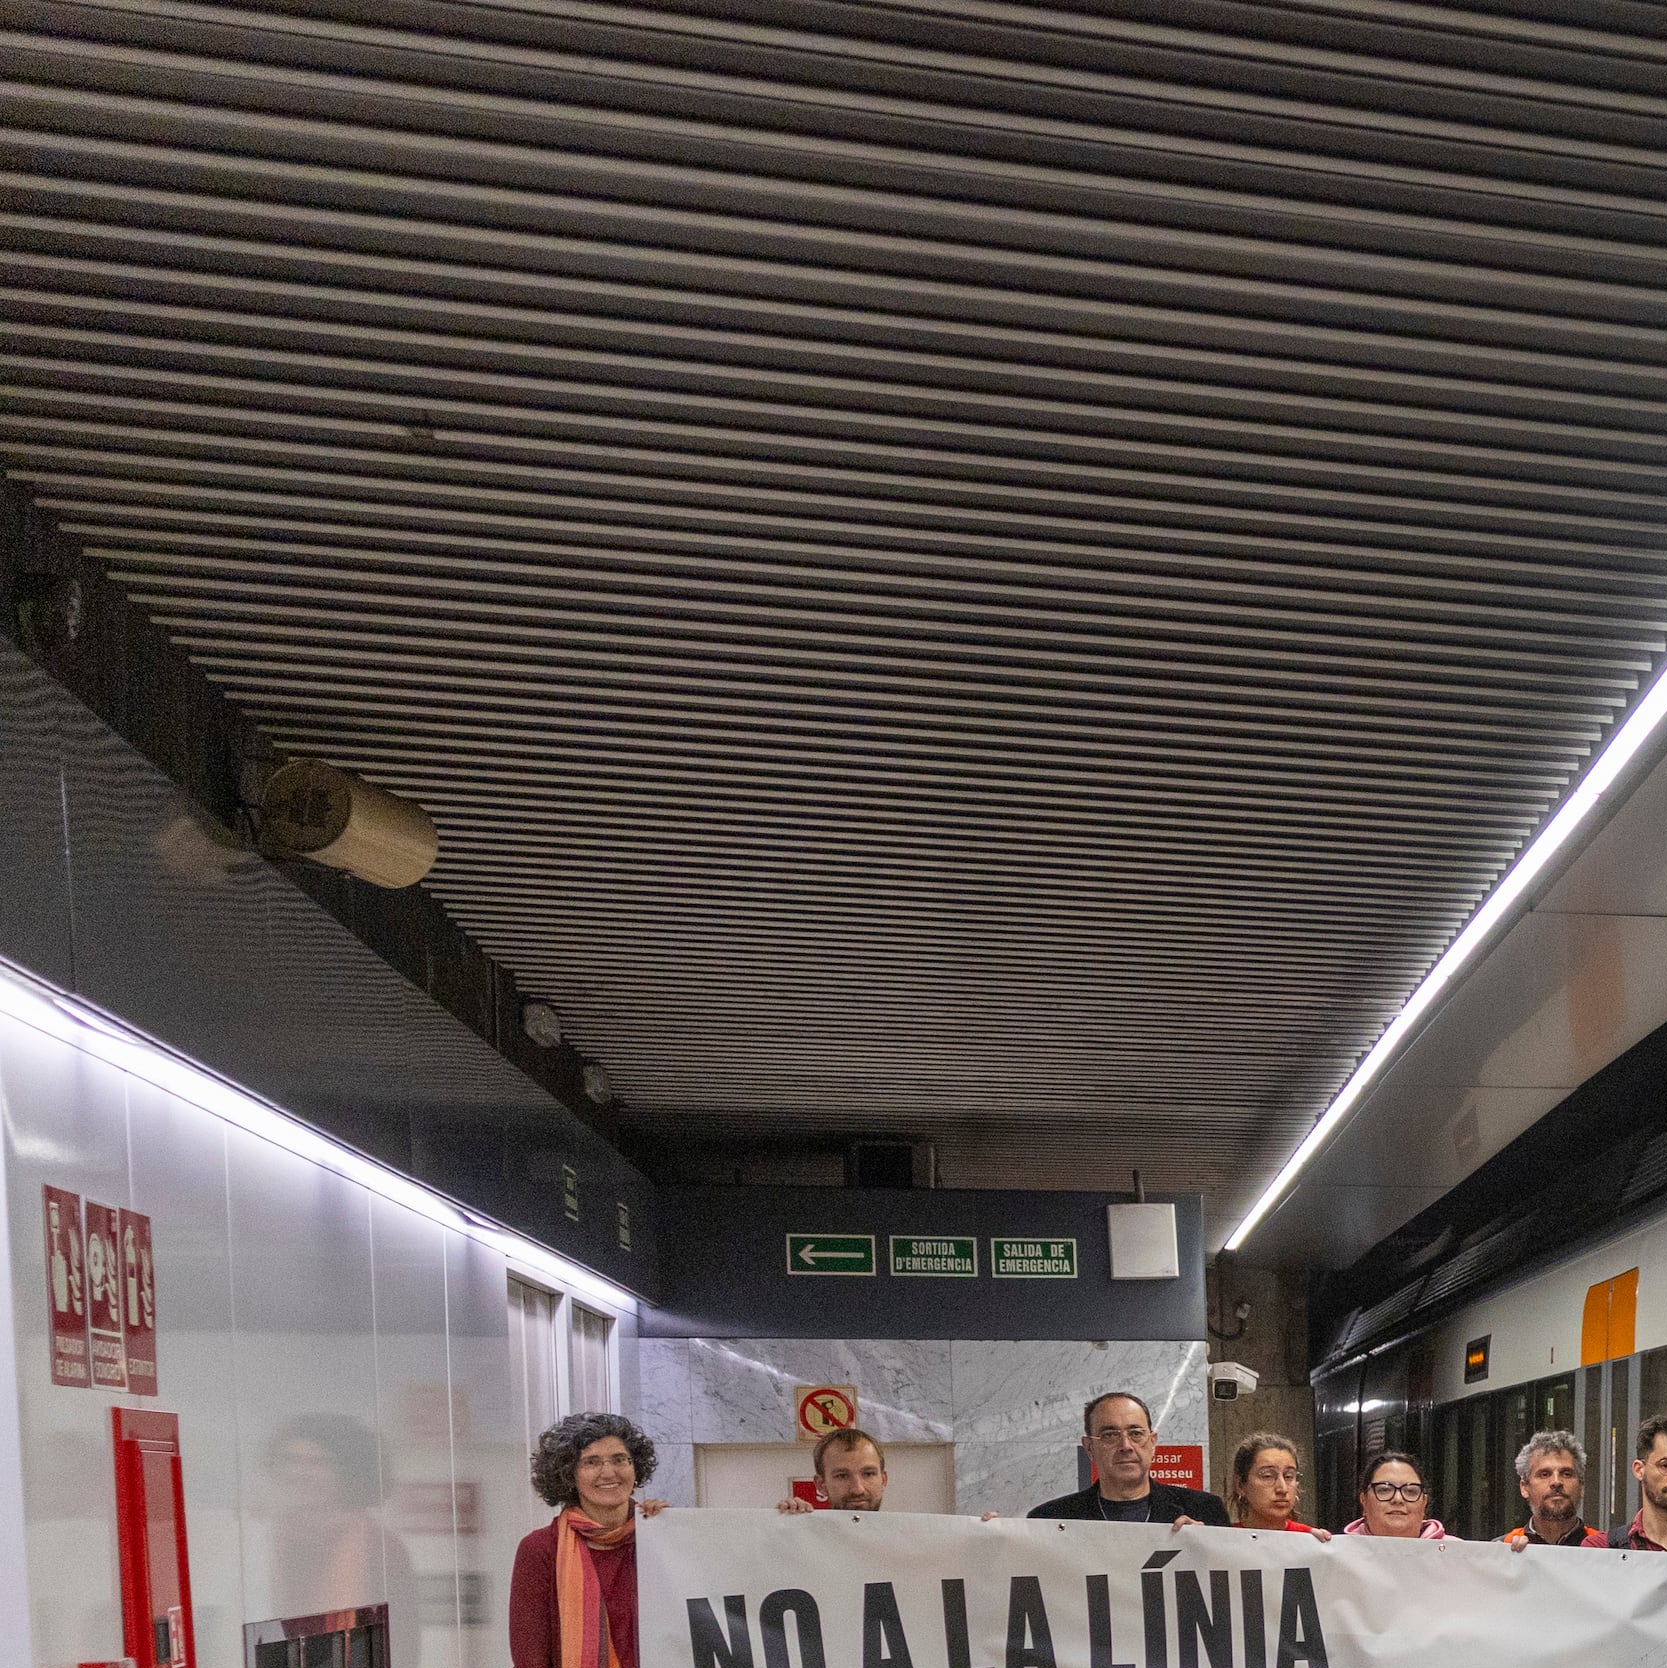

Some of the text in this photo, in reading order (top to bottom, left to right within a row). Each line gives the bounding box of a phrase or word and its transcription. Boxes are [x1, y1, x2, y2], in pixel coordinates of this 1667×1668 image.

[911, 1241, 956, 1256] SORTIDA
[1003, 1243, 1065, 1258] SALIDA DE
[999, 1259, 1071, 1273] EMERGENCIA
